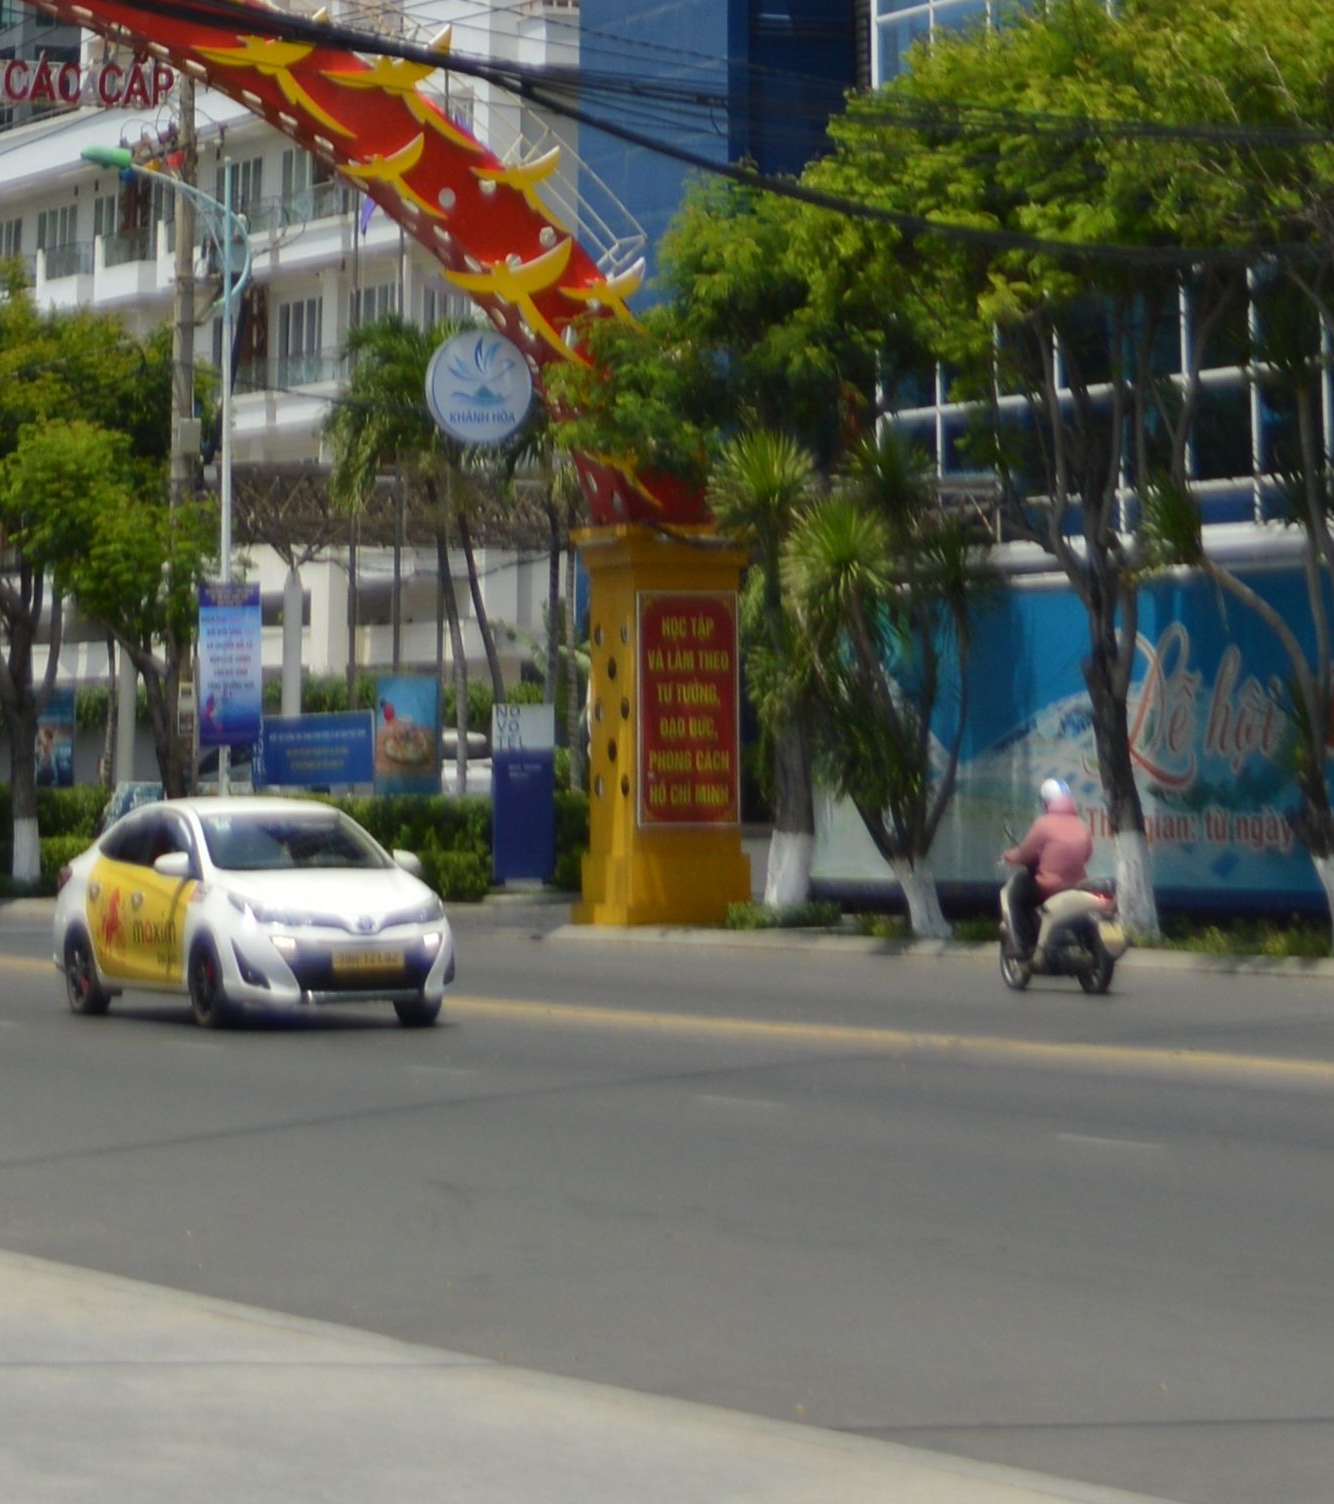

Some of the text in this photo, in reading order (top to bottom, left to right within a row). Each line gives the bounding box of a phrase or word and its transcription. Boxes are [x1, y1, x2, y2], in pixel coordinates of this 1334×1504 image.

[5, 49, 82, 103] CÁC
[99, 50, 175, 107] CẤP
[449, 409, 515, 423] KHÁNH HÒA
[662, 616, 687, 640] HỌC
[648, 644, 729, 670] VÀ LÀM THEO
[650, 747, 729, 770] PHONG CÁCH
[696, 784, 729, 805] MINH
[133, 912, 176, 944] maxim
